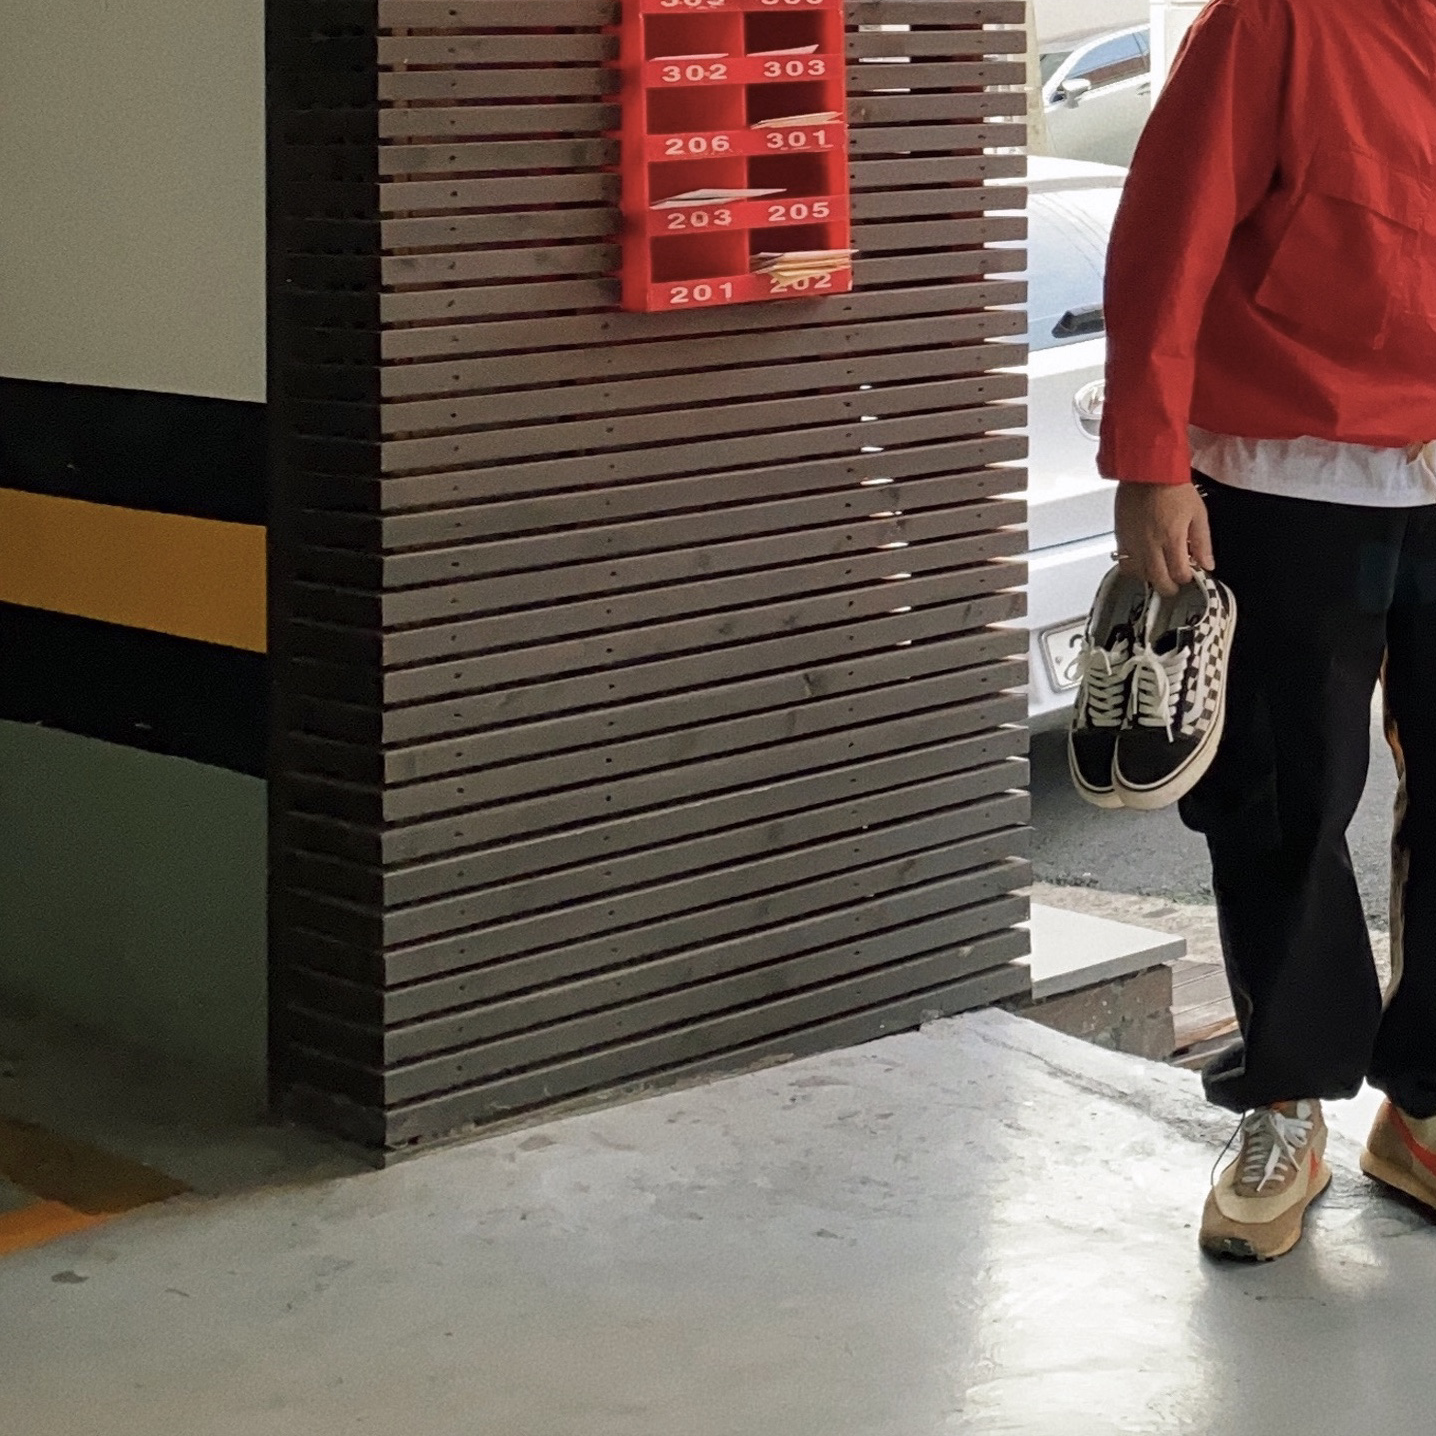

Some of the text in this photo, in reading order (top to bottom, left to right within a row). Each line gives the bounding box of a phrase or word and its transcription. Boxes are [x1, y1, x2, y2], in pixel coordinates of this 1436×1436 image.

[661, 63, 728, 83] 302
[763, 59, 827, 78] 303
[664, 134, 731, 156] 206
[766, 129, 827, 149] 301
[667, 208, 733, 230] 203
[767, 201, 831, 222] 205
[669, 281, 734, 304] 201
